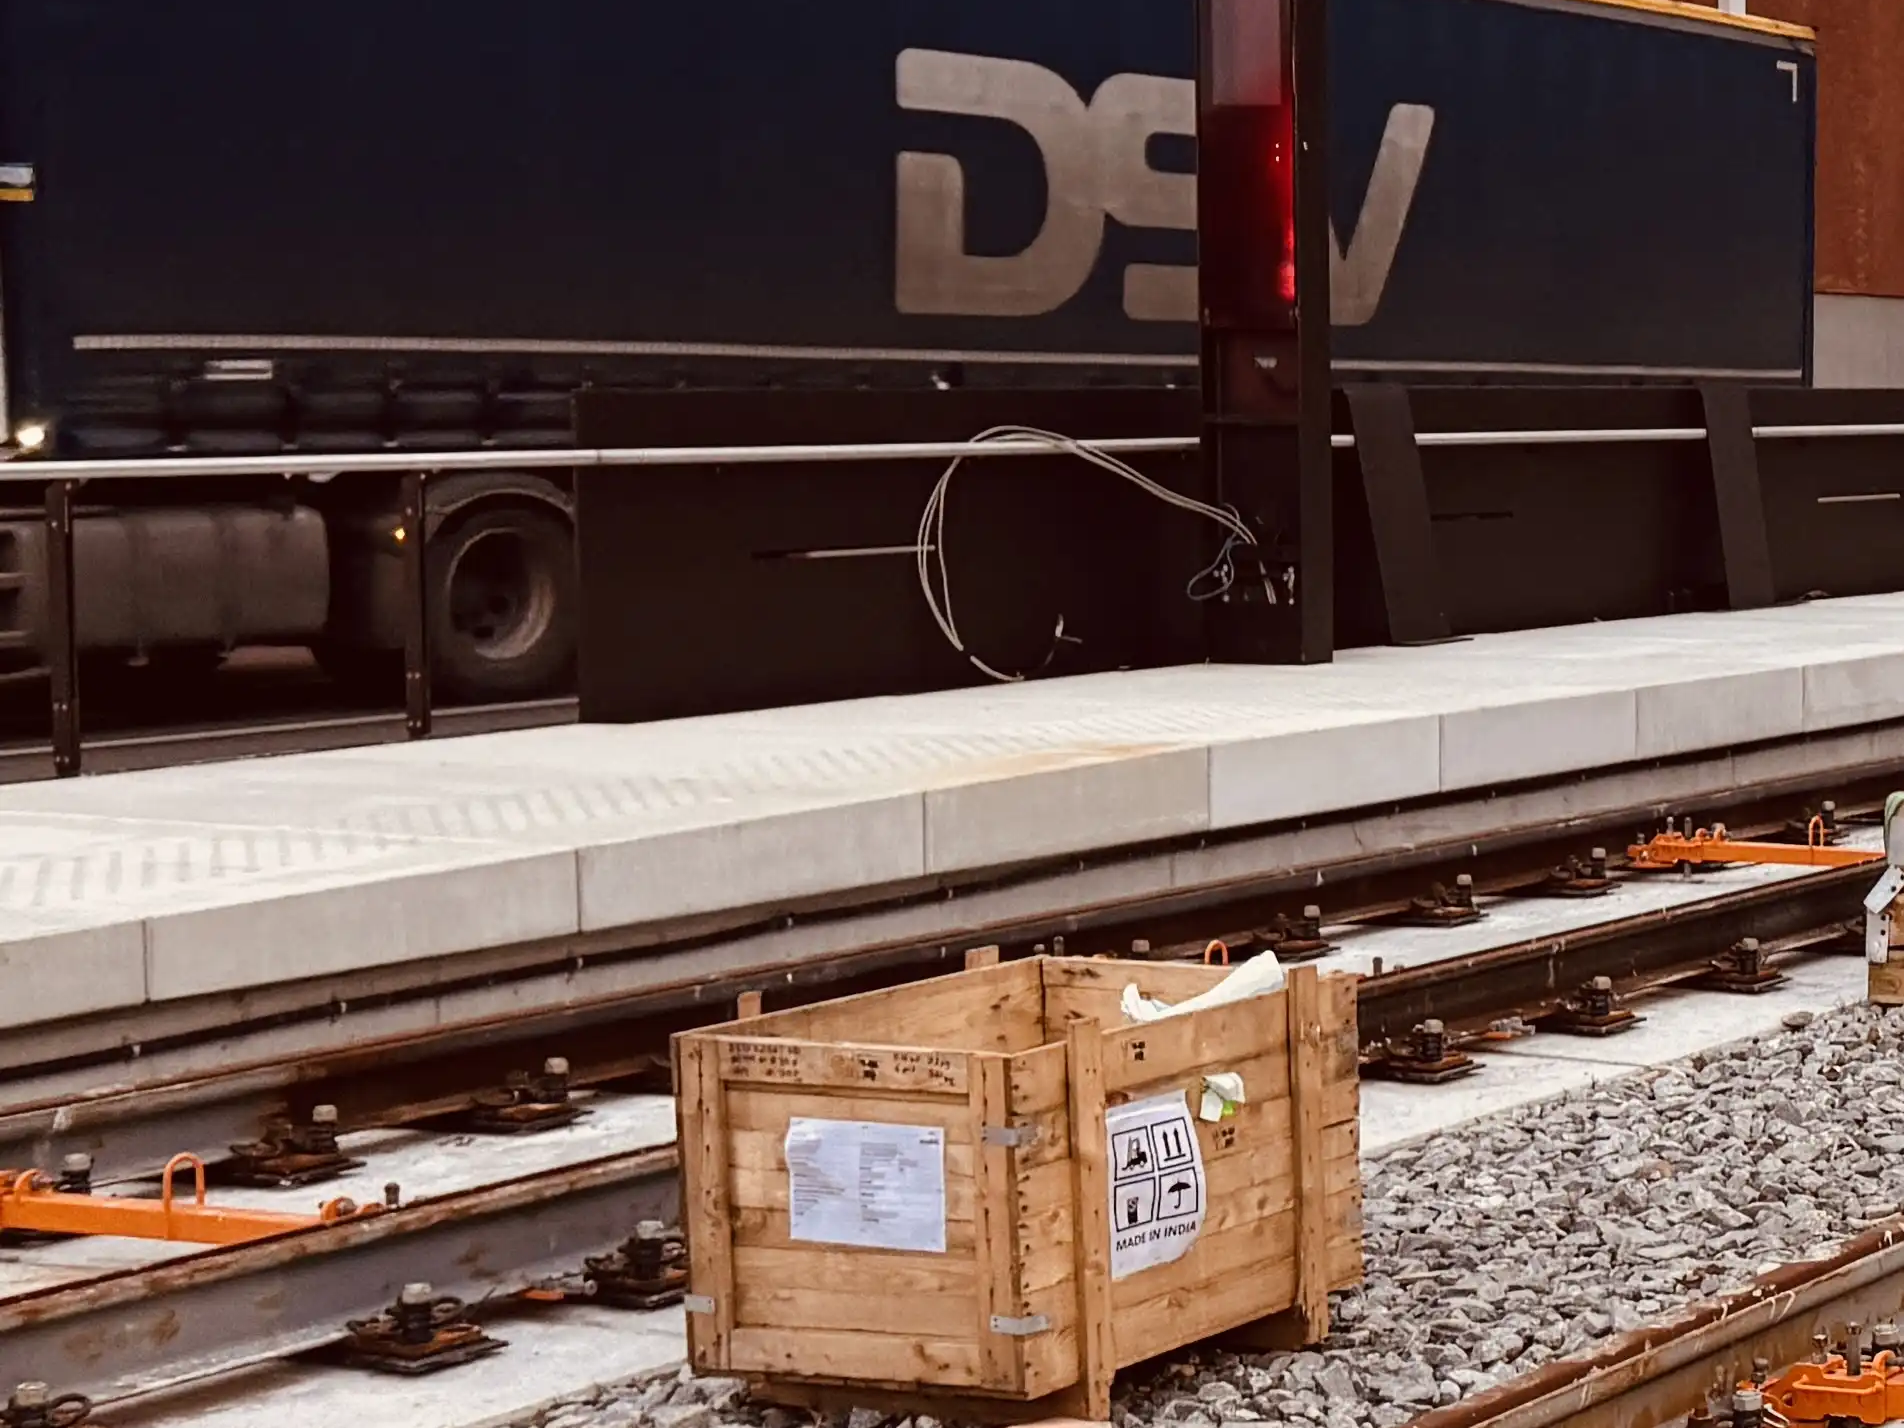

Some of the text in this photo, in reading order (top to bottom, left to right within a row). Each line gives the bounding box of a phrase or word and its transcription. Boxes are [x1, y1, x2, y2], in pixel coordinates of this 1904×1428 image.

[1116, 1220, 1196, 1251] MADE IN INDIA
